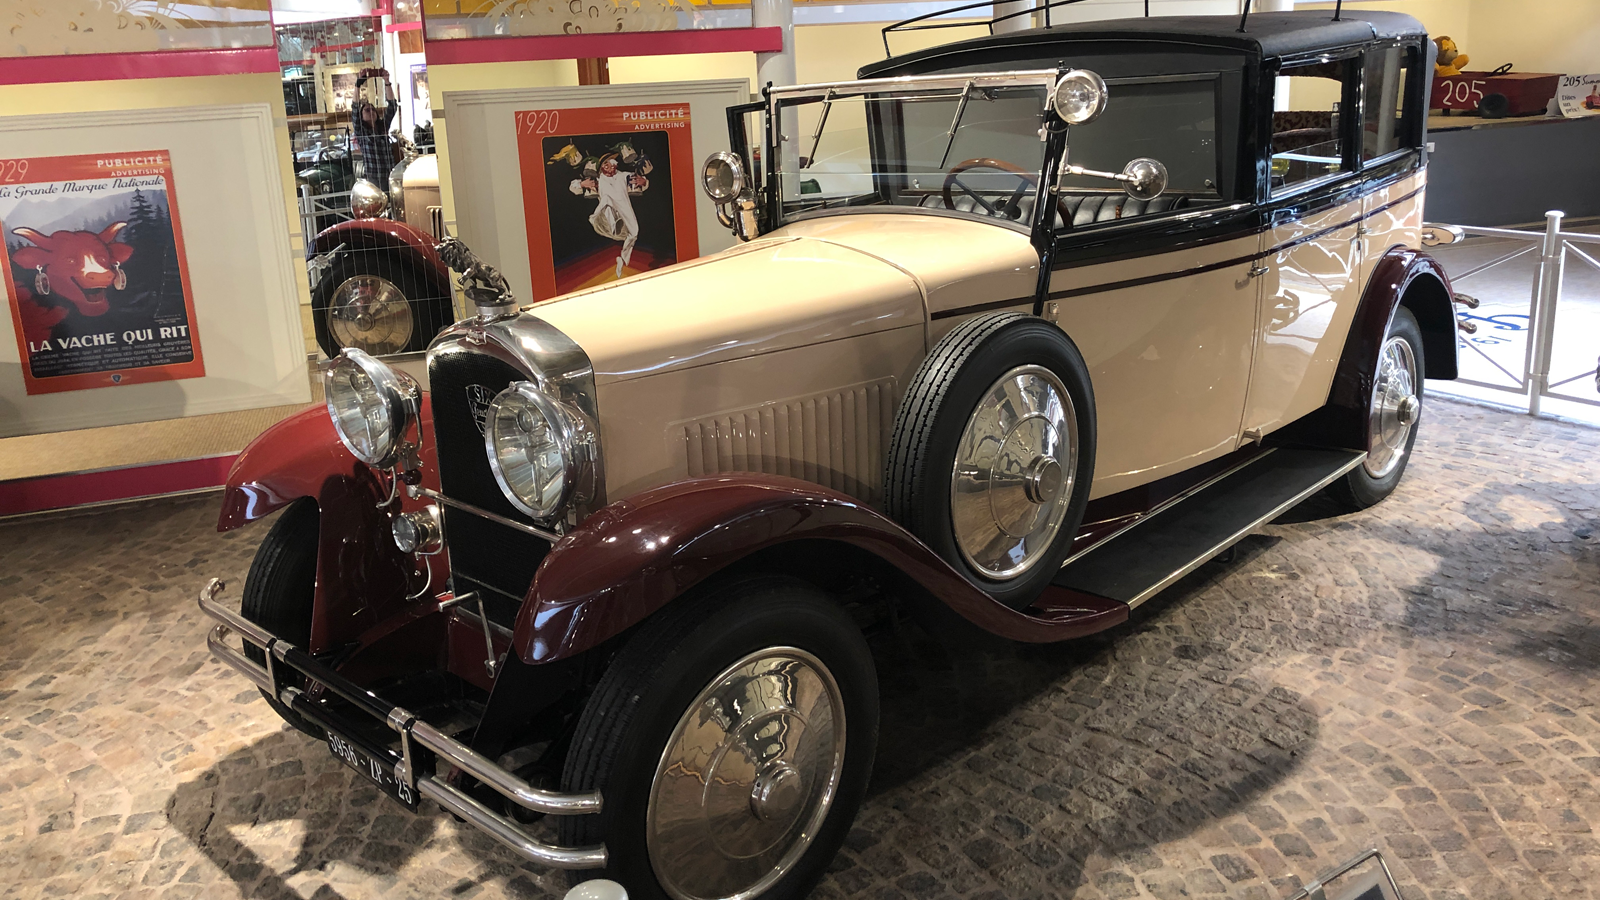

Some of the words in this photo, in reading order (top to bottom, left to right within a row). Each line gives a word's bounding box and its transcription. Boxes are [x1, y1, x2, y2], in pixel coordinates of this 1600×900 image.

[1562, 76, 1581, 87] 205
[1441, 80, 1486, 108] 205
[622, 107, 685, 121] PUBLICITÉ
[516, 110, 560, 135] 1920
[634, 122, 685, 131] ADVERTISING
[97, 155, 164, 169] PUBLICITÉ
[111, 167, 165, 178] ADVERTISING
[15, 185, 59, 200] Grande
[62, 181, 108, 196] Marque
[112, 176, 164, 190] Nationale
[30, 340, 53, 353] LA
[57, 333, 117, 350] VACHE
[123, 329, 153, 346] QUI
[160, 325, 188, 338] RIT
